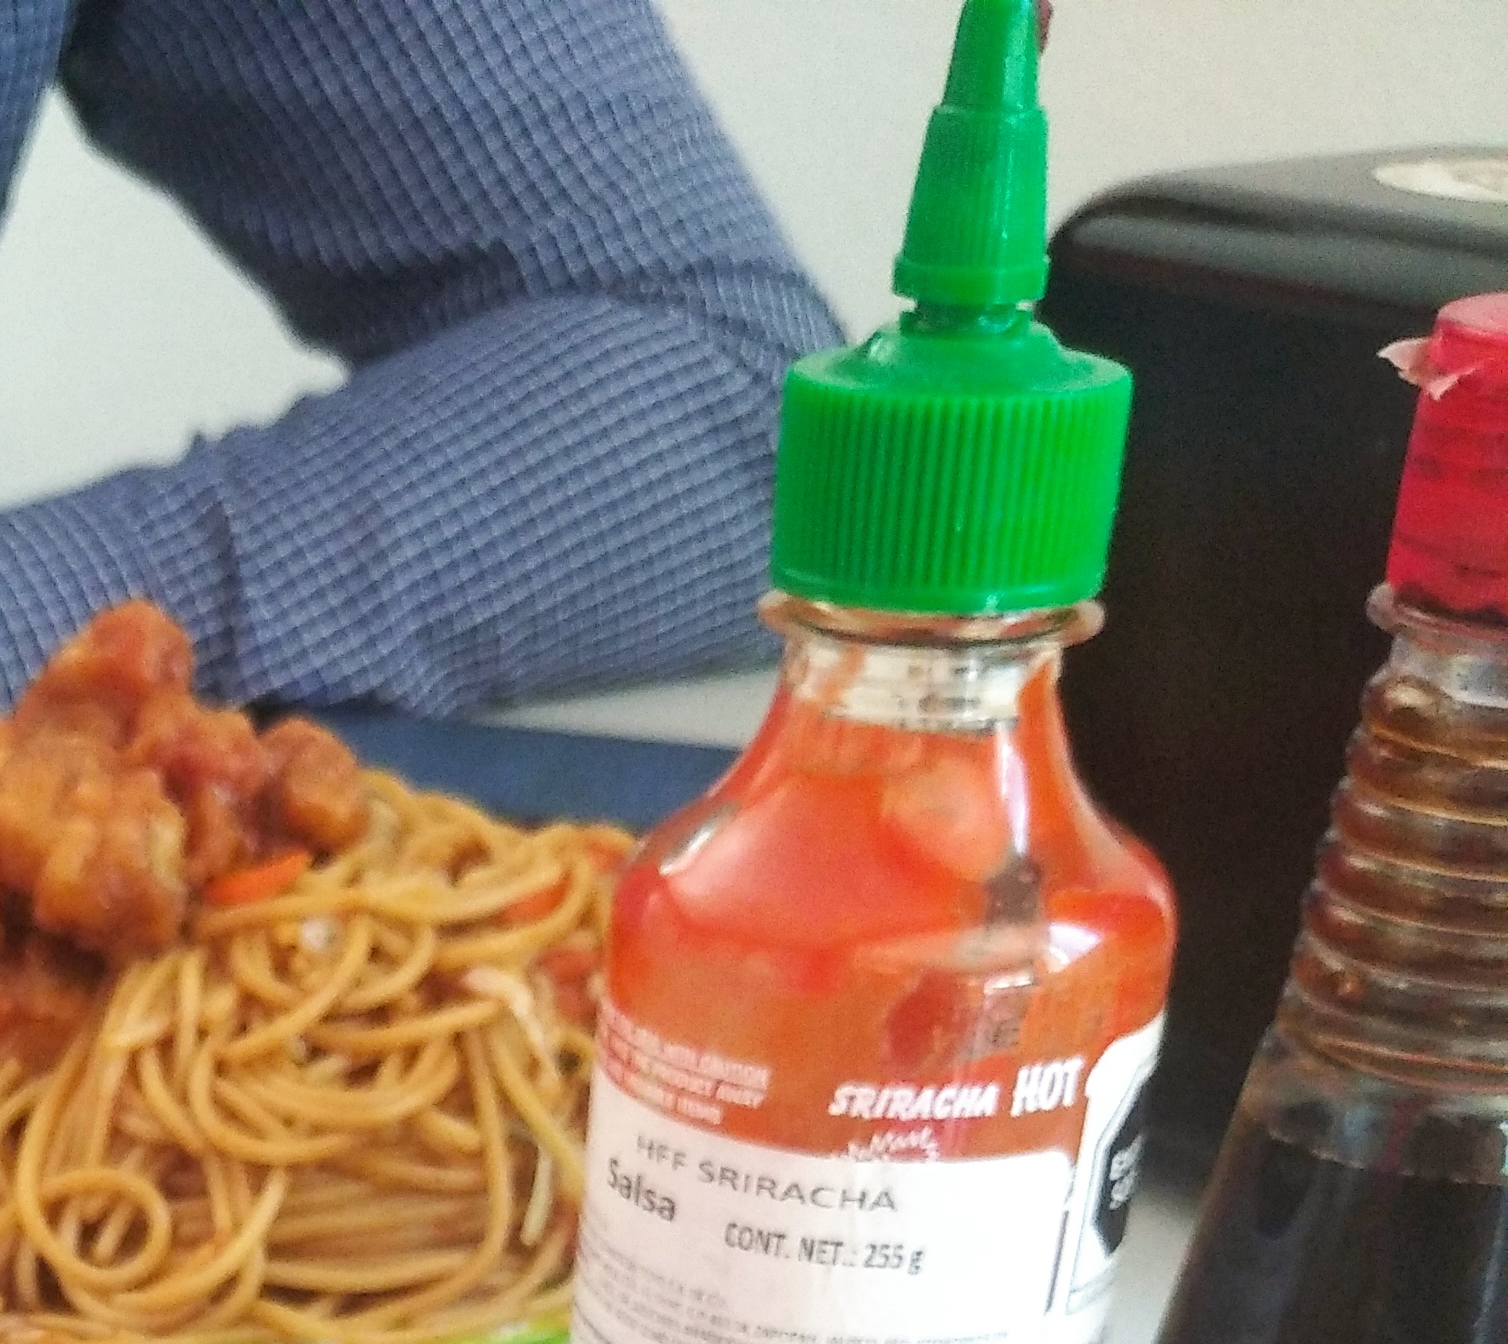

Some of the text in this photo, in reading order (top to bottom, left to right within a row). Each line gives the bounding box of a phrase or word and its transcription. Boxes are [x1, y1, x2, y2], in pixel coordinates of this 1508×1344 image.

[828, 1056, 1085, 1121] SRIRACHA HOT
[608, 1156, 677, 1223] Salsa
[637, 1134, 898, 1213] HFF SRIRACHA
[724, 1221, 791, 1260] CONT.
[863, 1243, 904, 1269] 255
[908, 1248, 924, 1276] g
